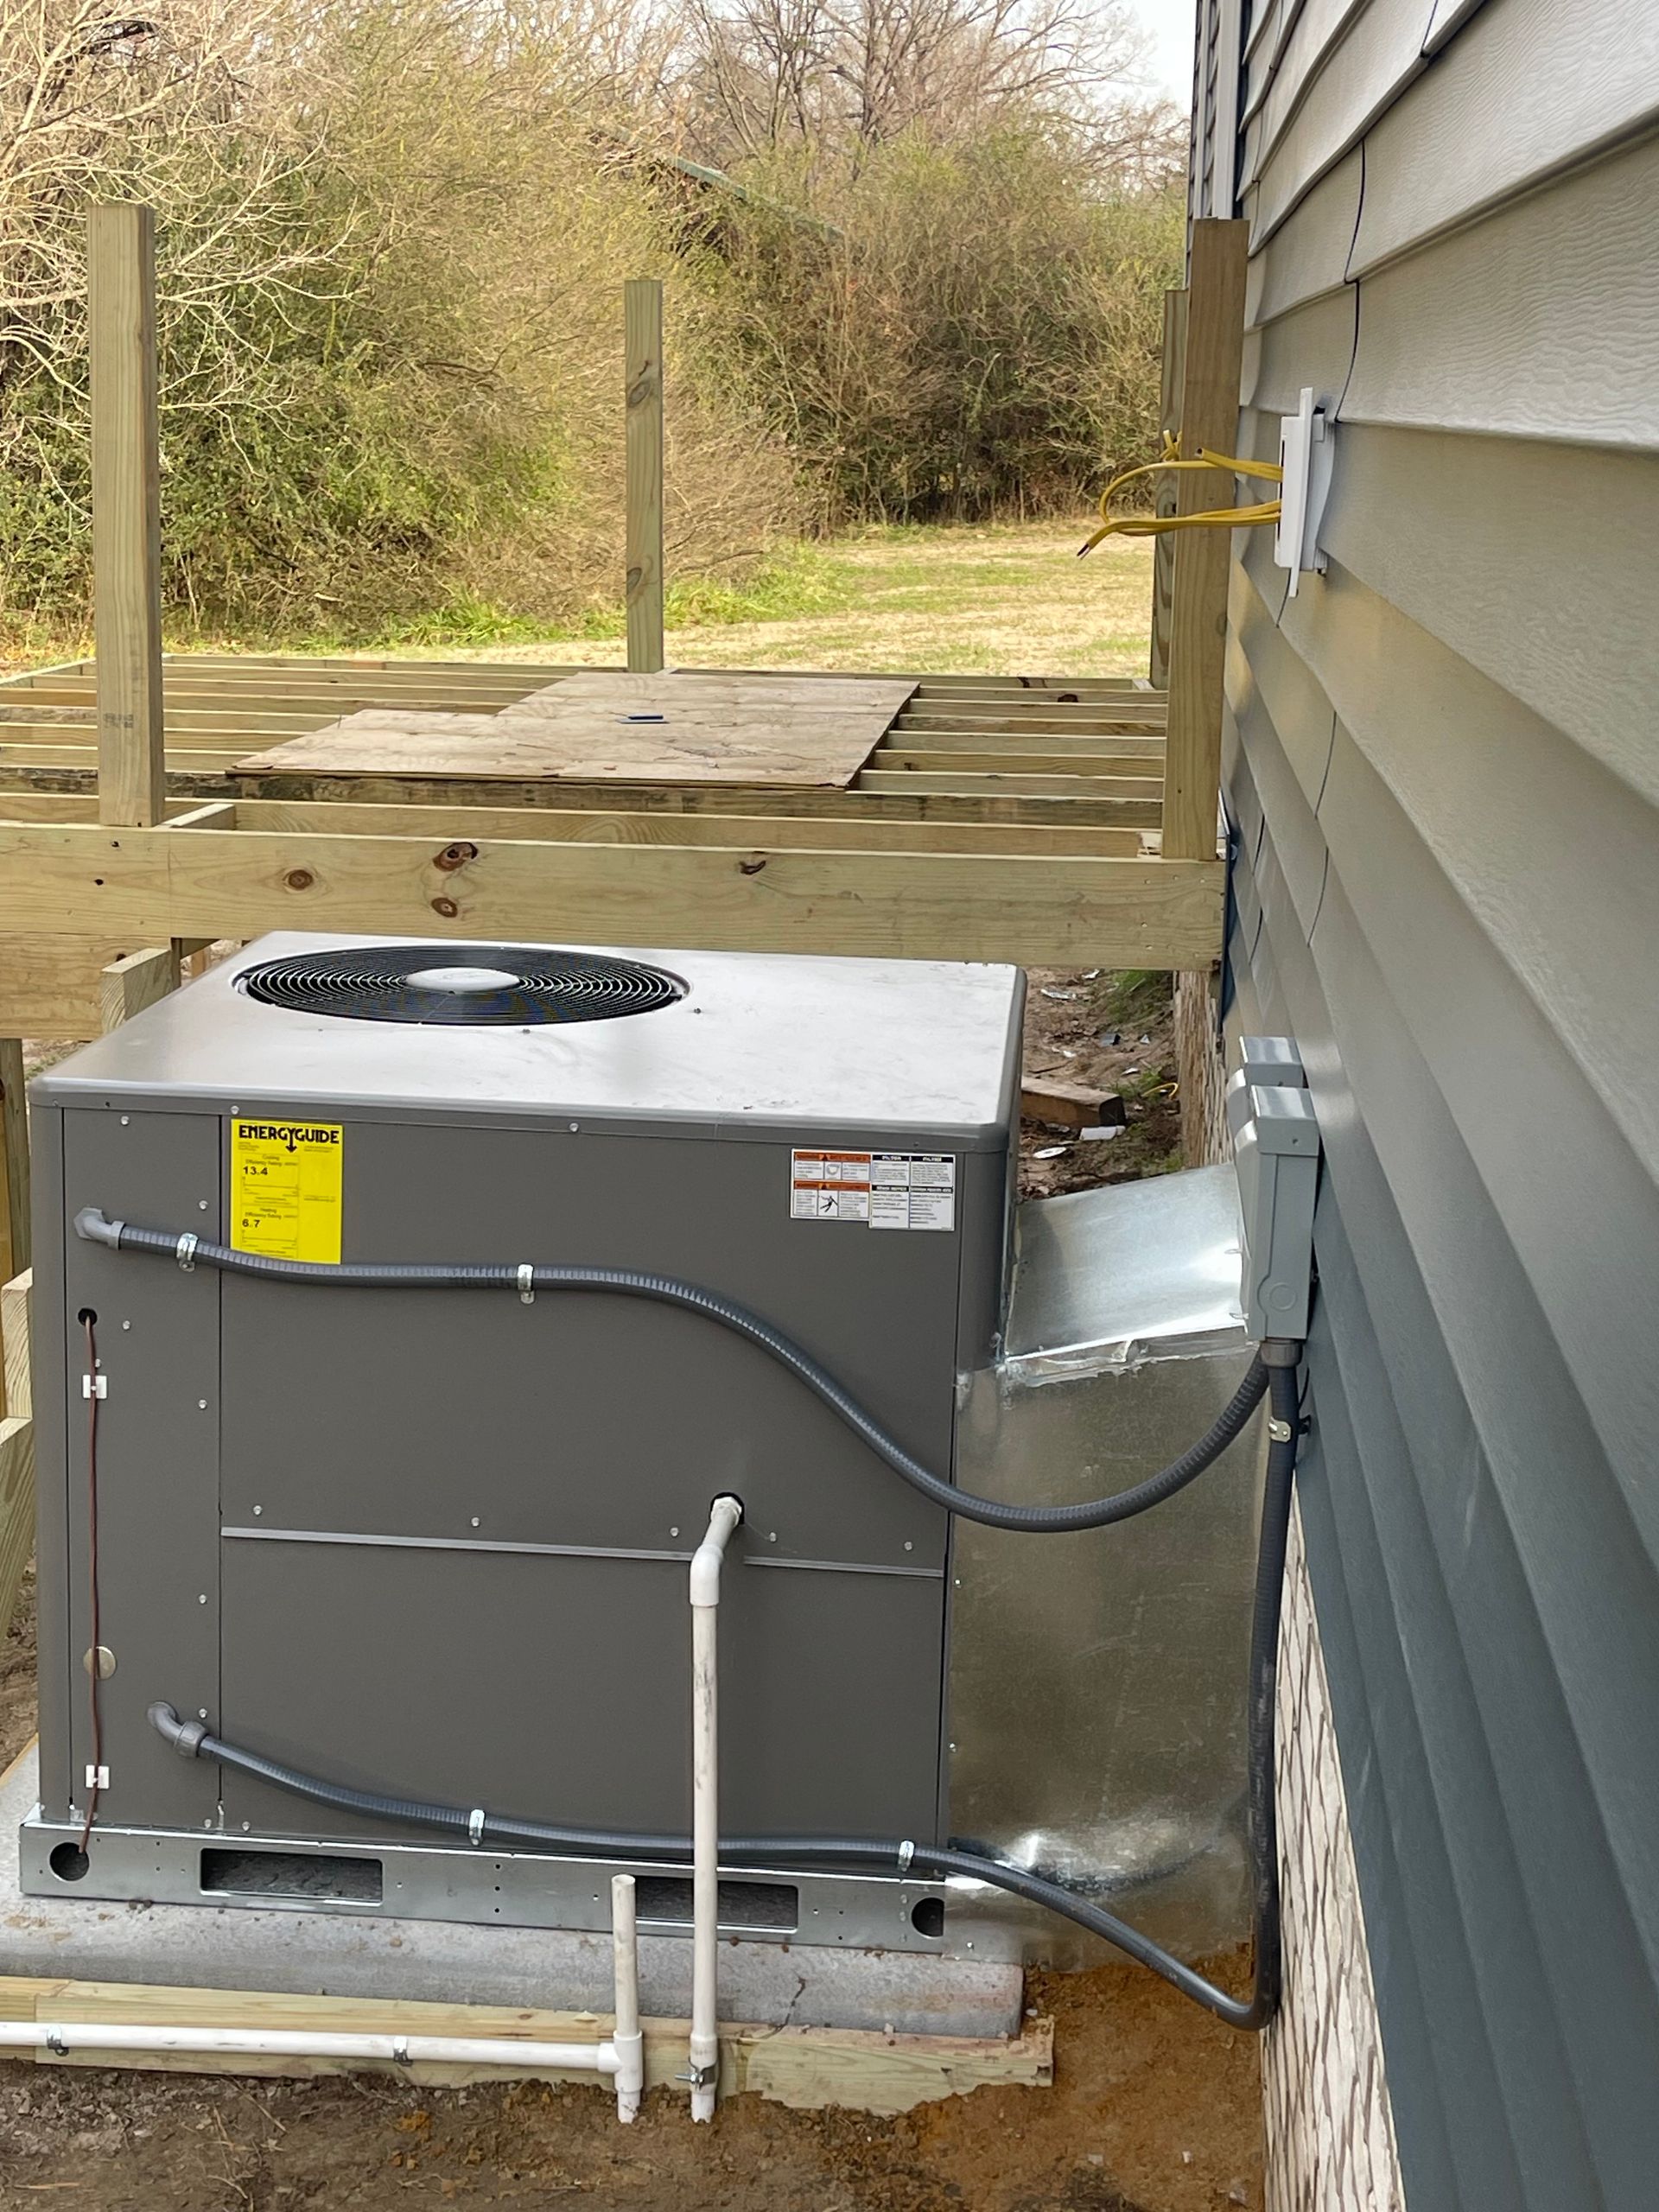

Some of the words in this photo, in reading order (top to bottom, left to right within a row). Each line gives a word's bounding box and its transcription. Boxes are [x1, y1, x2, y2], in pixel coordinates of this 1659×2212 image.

[238, 1125, 340, 1146] ENERGYGUIDE
[243, 1166, 268, 1175] 13.4
[242, 1218, 261, 1228] 6.7
